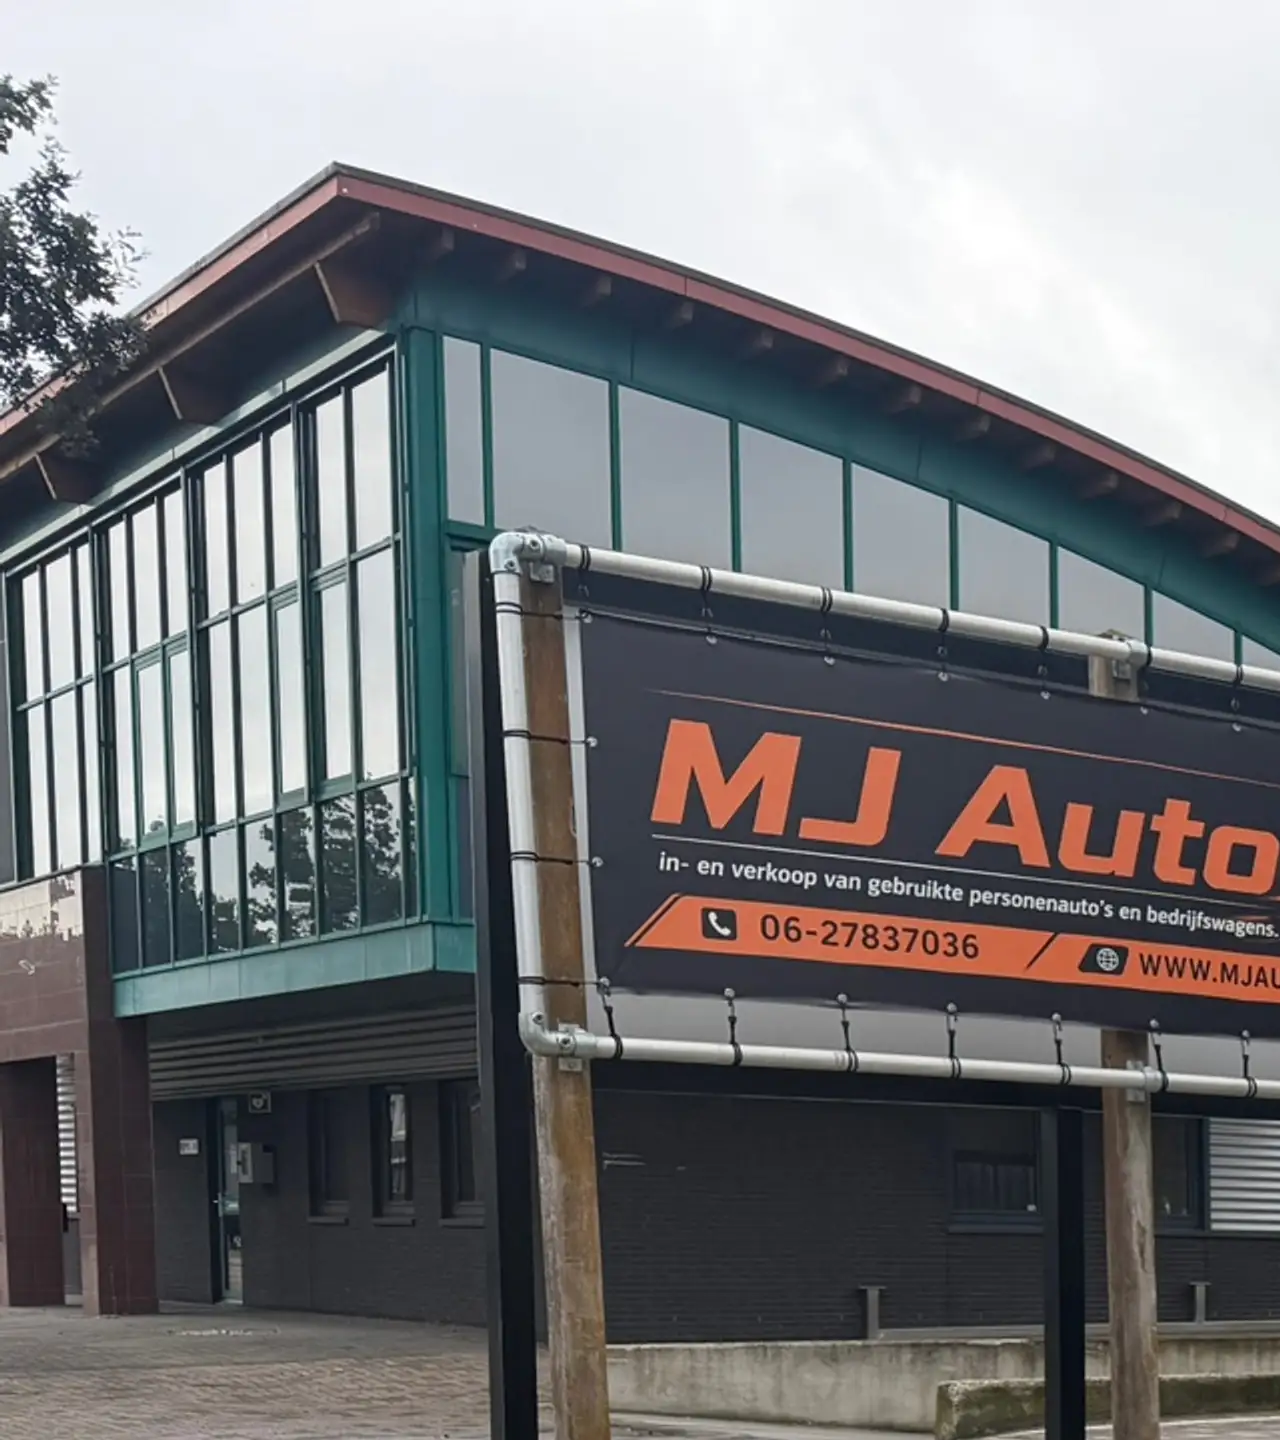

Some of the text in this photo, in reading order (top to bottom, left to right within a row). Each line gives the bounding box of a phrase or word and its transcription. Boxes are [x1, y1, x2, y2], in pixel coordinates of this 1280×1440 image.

[651, 718, 1280, 896] MJ Auto
[659, 851, 1280, 939] in- en verkoop van gebruikte personenauto's en bedrijfswagens.
[760, 914, 980, 959] 06-27837036
